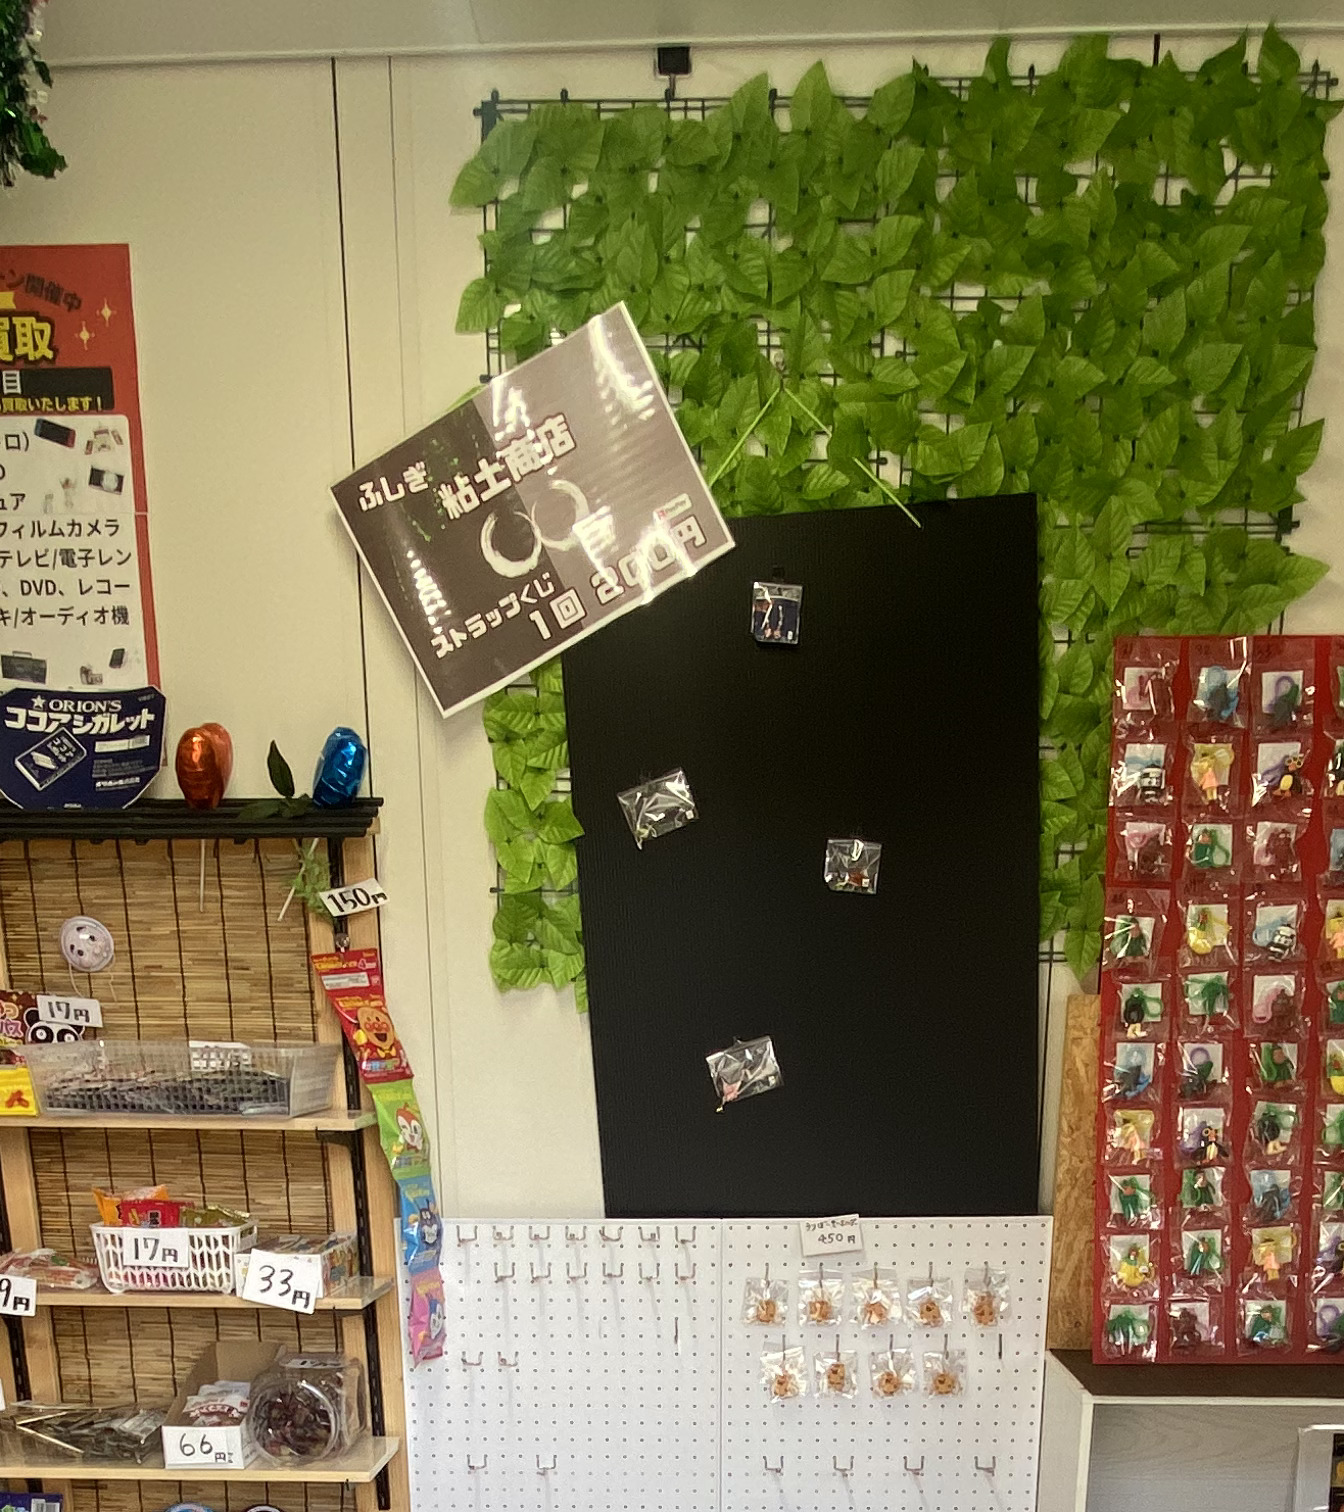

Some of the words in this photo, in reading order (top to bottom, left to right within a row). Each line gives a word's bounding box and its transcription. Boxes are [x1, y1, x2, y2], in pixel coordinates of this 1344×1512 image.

[359, 461, 431, 513] ふしぎ
[431, 571, 555, 659] ストラップくじ
[528, 587, 587, 641] 1回
[4, 705, 156, 736] ココアシガレット
[49, 697, 122, 714] ORION'S
[327, 884, 388, 914] 150円
[48, 1001, 91, 1024] 17円
[133, 1238, 179, 1263] 17円
[258, 1265, 311, 1310] 33円
